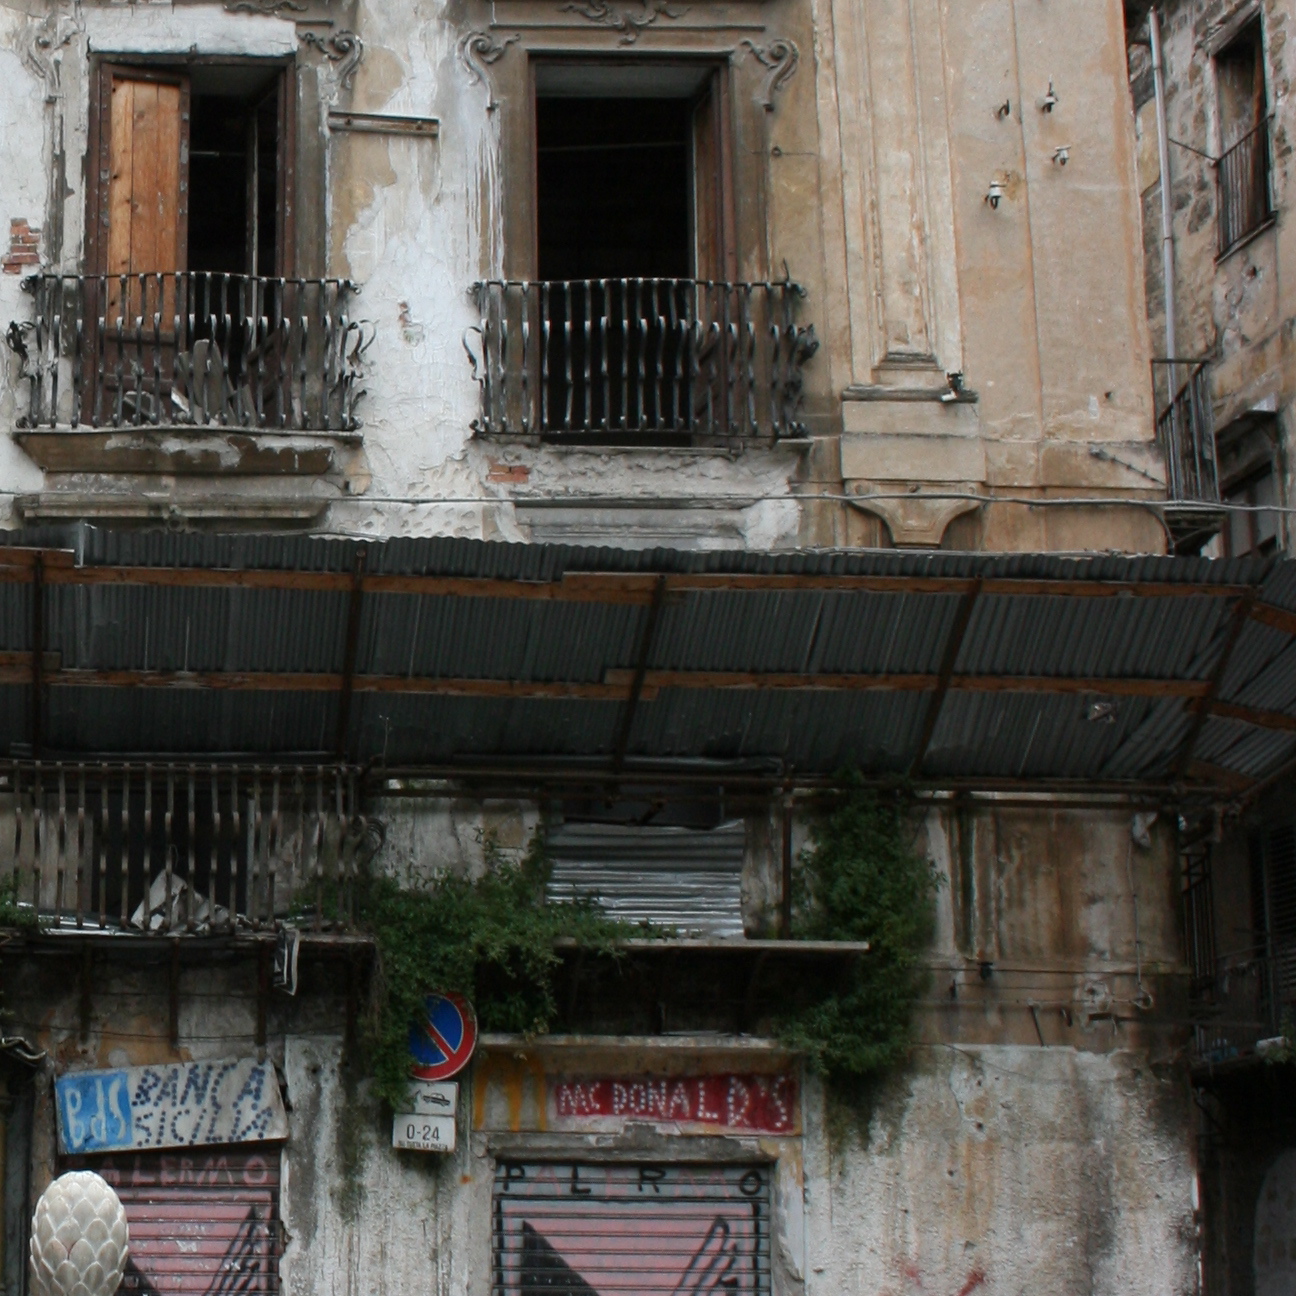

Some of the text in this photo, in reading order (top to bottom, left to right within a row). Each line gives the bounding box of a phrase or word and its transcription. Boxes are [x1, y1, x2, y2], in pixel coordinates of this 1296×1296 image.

[131, 1062, 266, 1108] BANCA
[64, 1077, 127, 1149] BdS
[135, 1106, 274, 1145] SICILIA
[406, 1123, 440, 1141] 0-24
[502, 1164, 763, 1198] PALERMO
